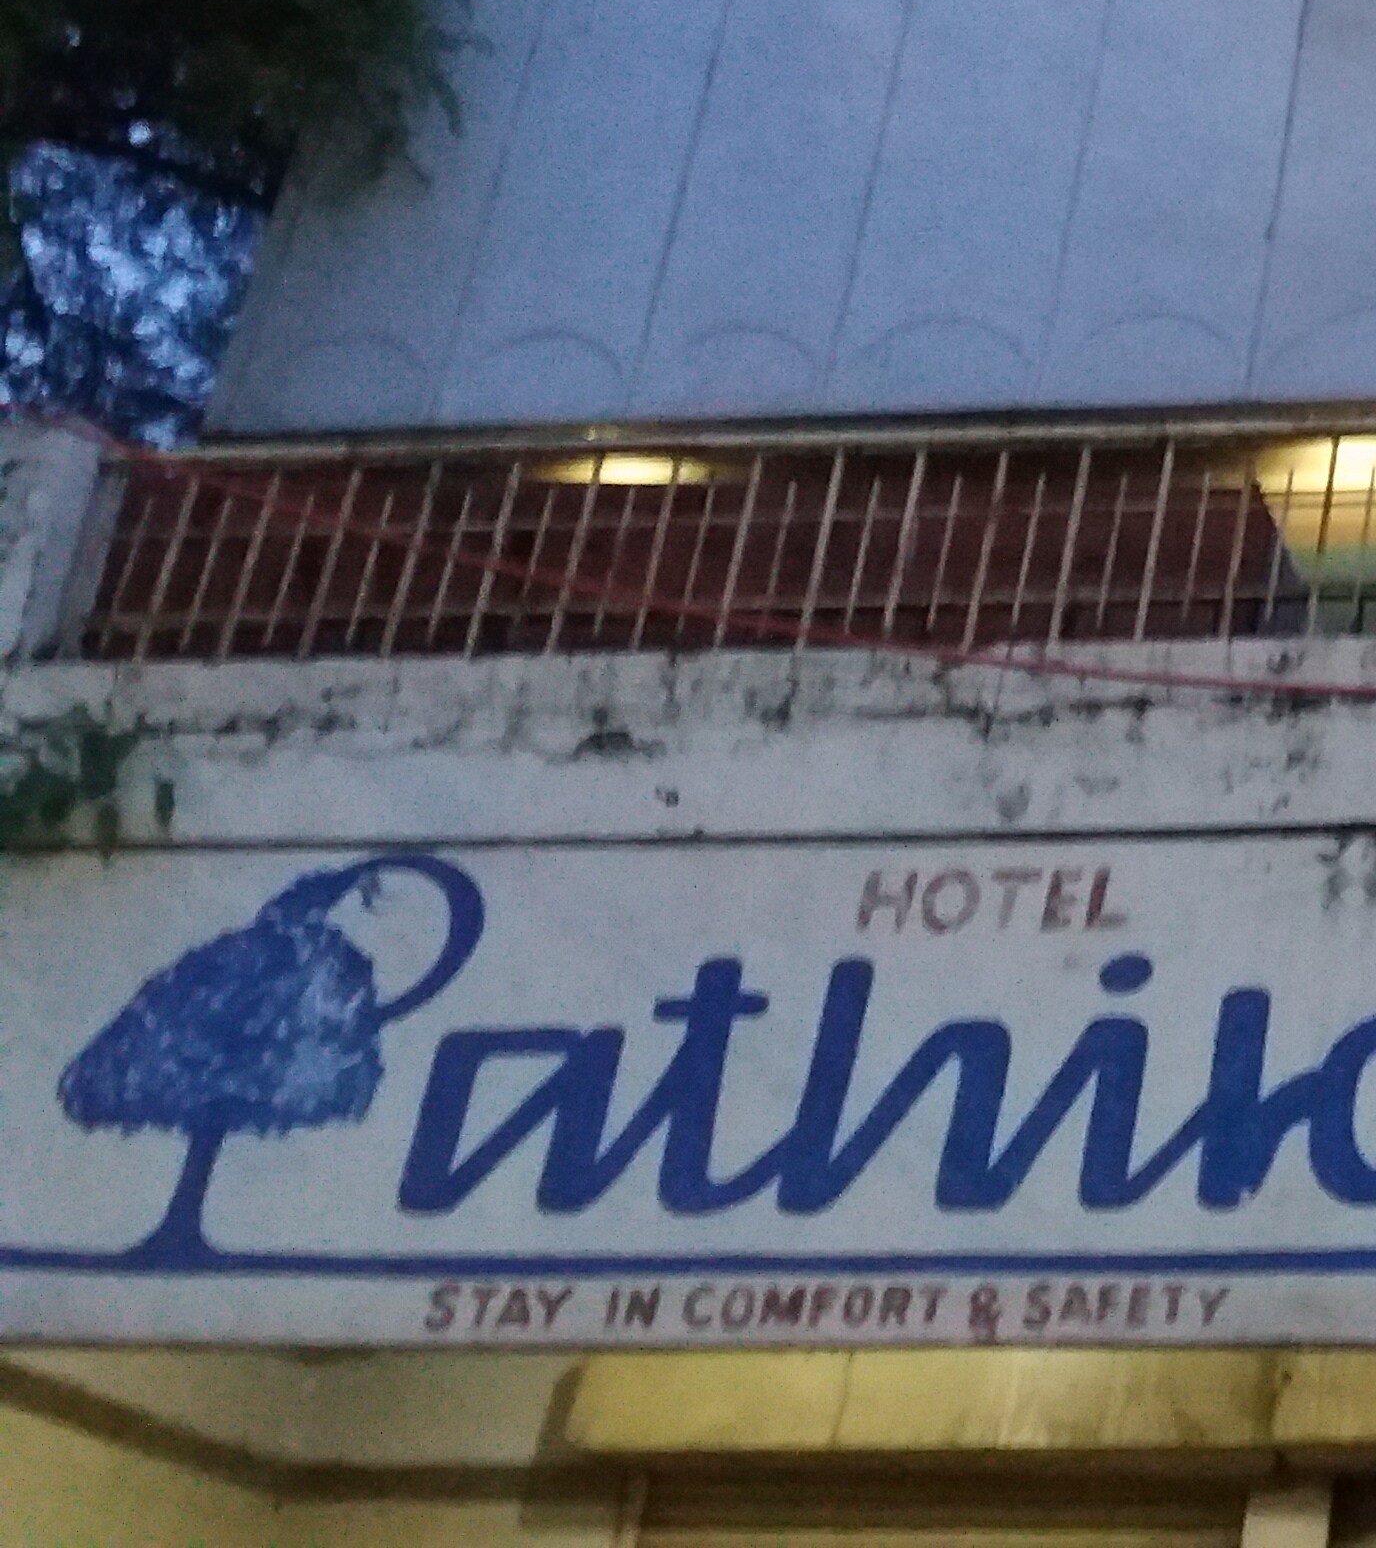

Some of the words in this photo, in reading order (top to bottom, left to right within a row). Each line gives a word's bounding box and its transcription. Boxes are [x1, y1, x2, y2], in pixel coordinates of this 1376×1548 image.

[855, 866, 1128, 934] HOTEL
[425, 1284, 573, 1332] STAY
[605, 1283, 661, 1329] IN
[682, 1284, 944, 1331] COMFORT
[966, 1285, 1002, 1340] &
[1022, 1283, 1231, 1328] SAFETY
